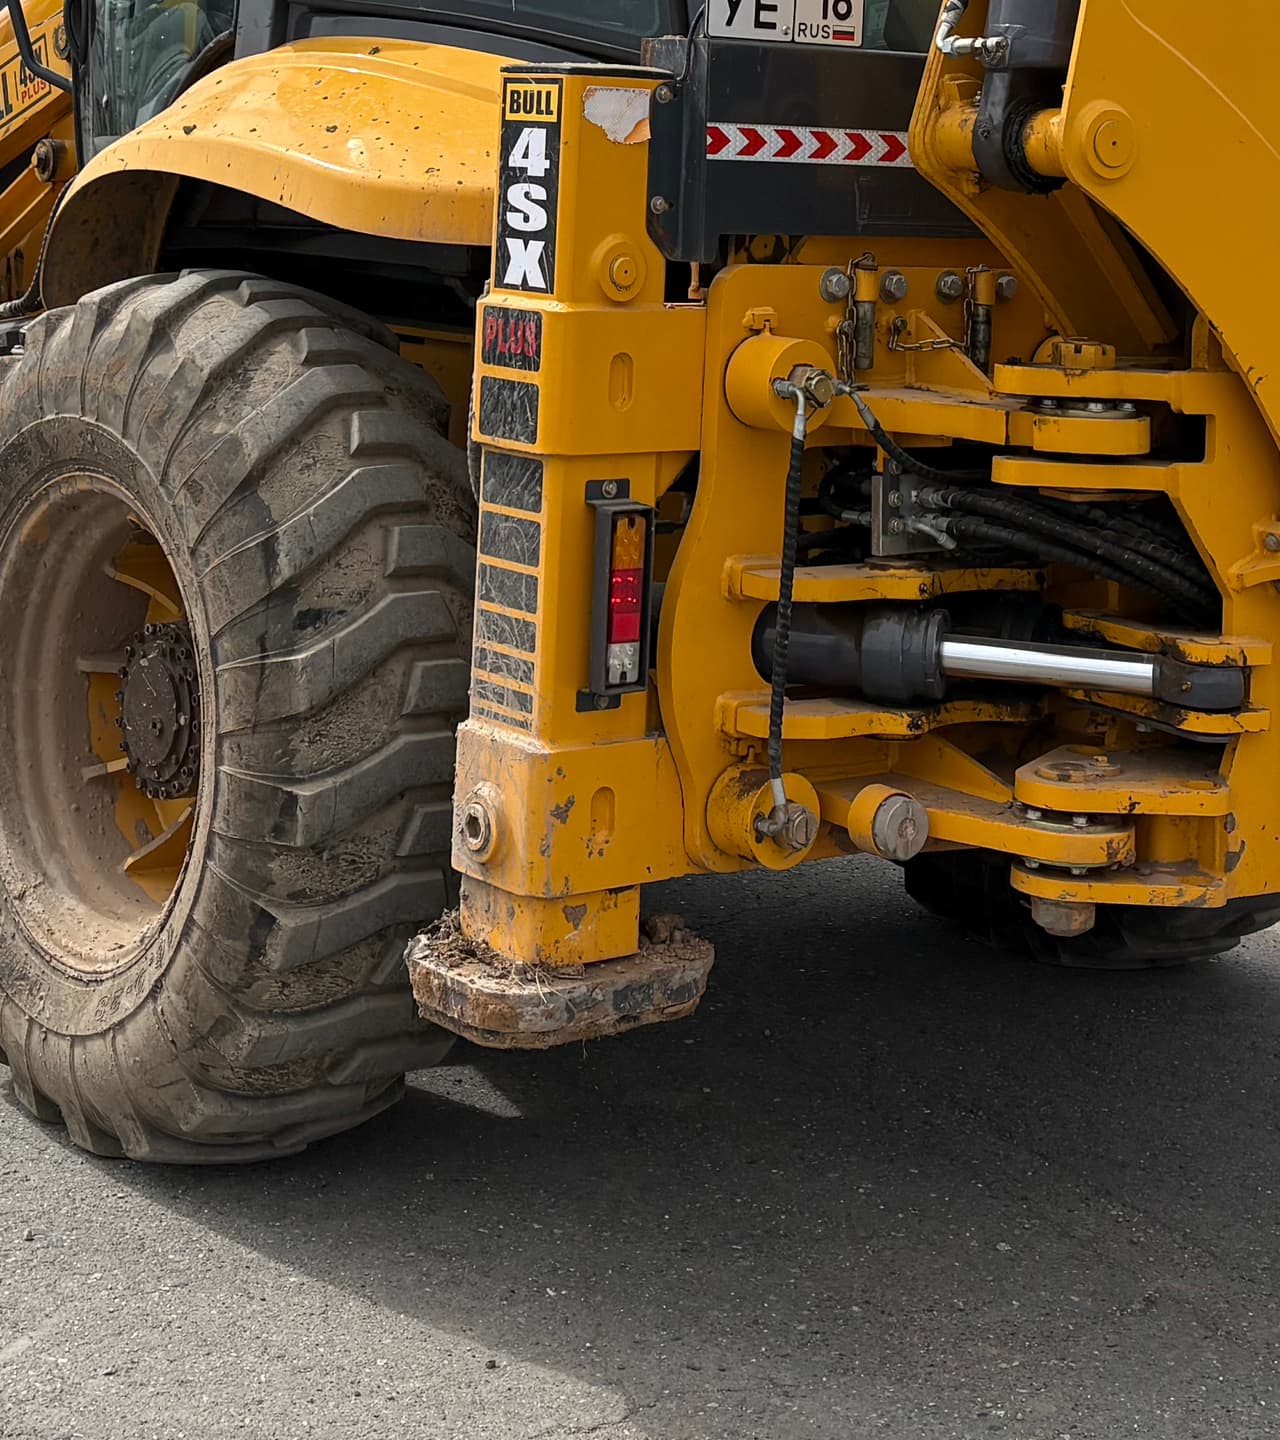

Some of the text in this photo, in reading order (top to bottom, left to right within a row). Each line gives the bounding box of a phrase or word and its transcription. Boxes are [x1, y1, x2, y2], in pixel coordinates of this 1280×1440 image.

[797, 22, 831, 39] RUS
[21, 80, 47, 104] PLUS
[509, 89, 554, 116] BULL
[504, 127, 550, 289] 4SX
[485, 316, 538, 359] PLUS
